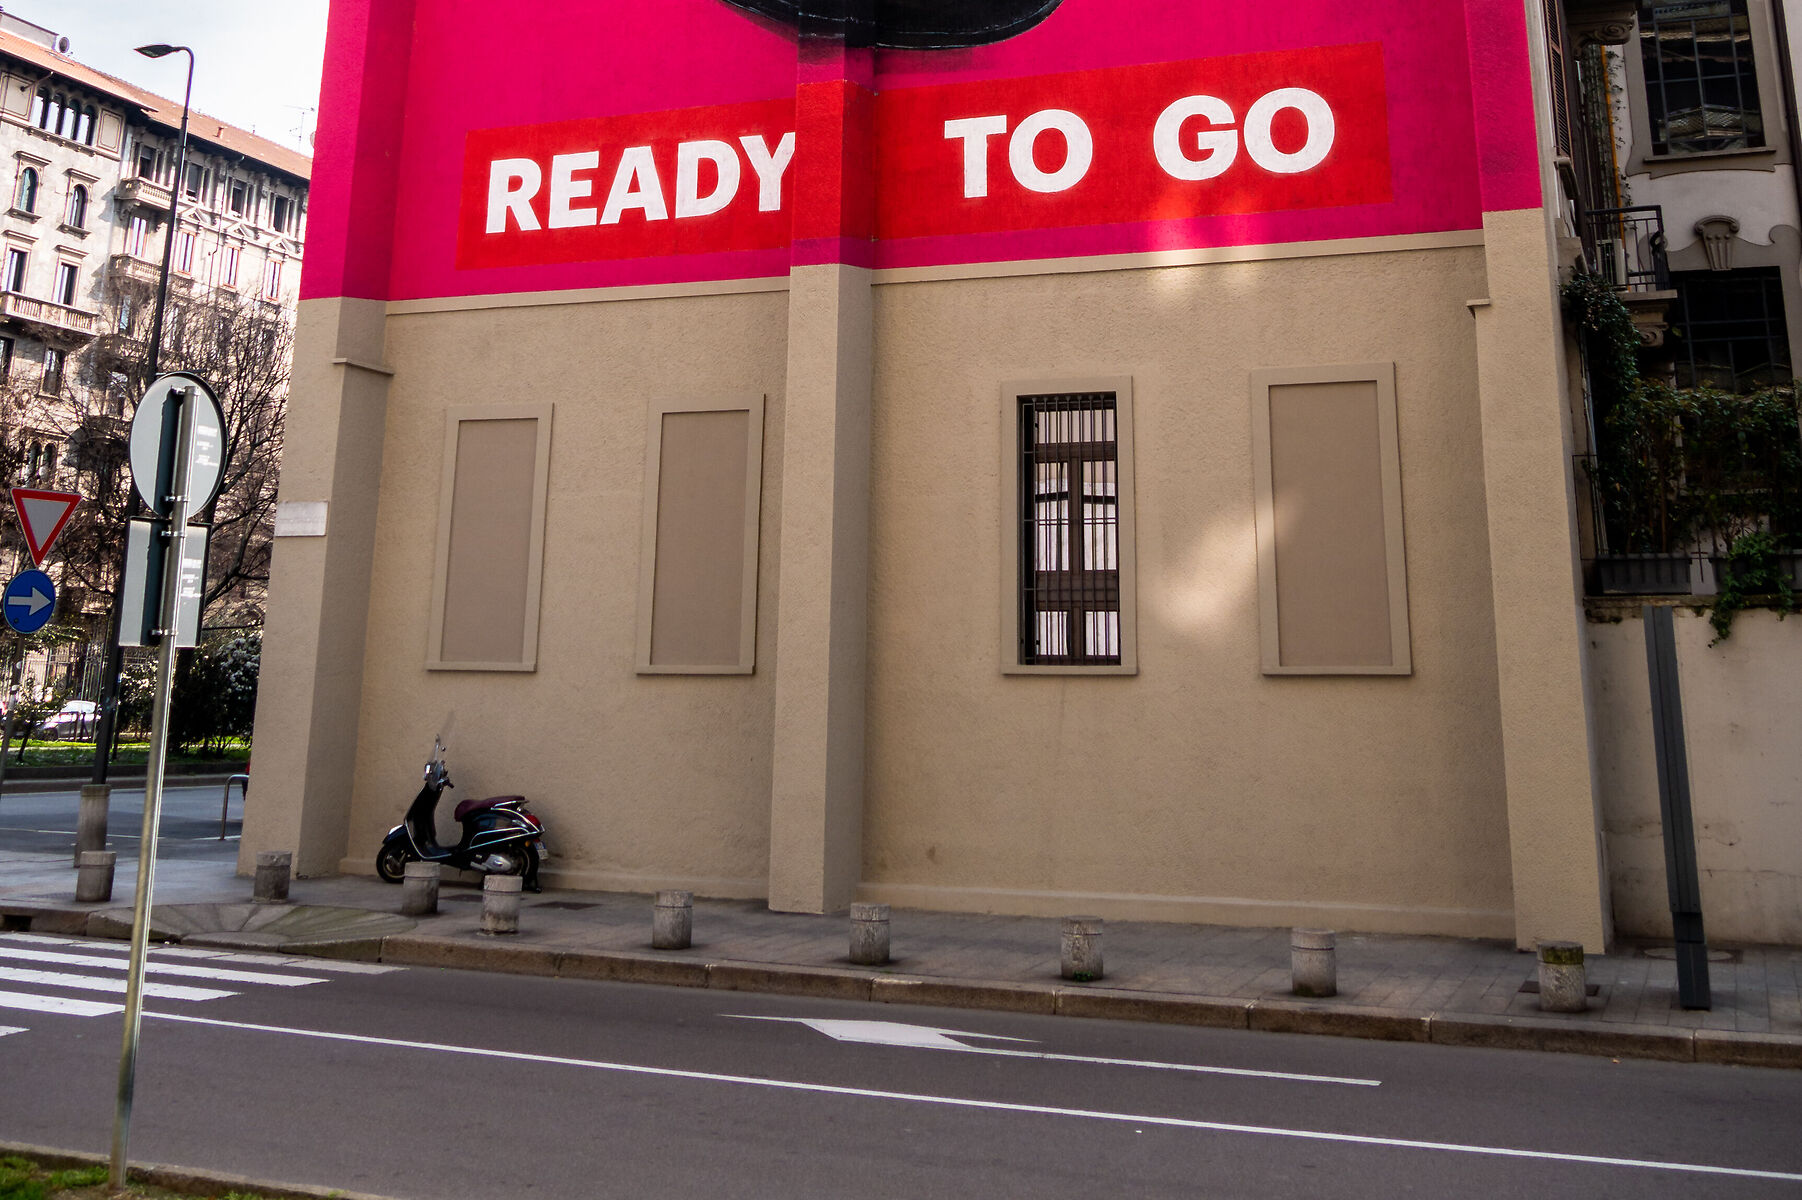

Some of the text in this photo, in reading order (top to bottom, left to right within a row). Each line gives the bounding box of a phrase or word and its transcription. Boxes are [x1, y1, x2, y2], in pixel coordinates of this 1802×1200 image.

[485, 87, 1335, 234] READY TO GO
